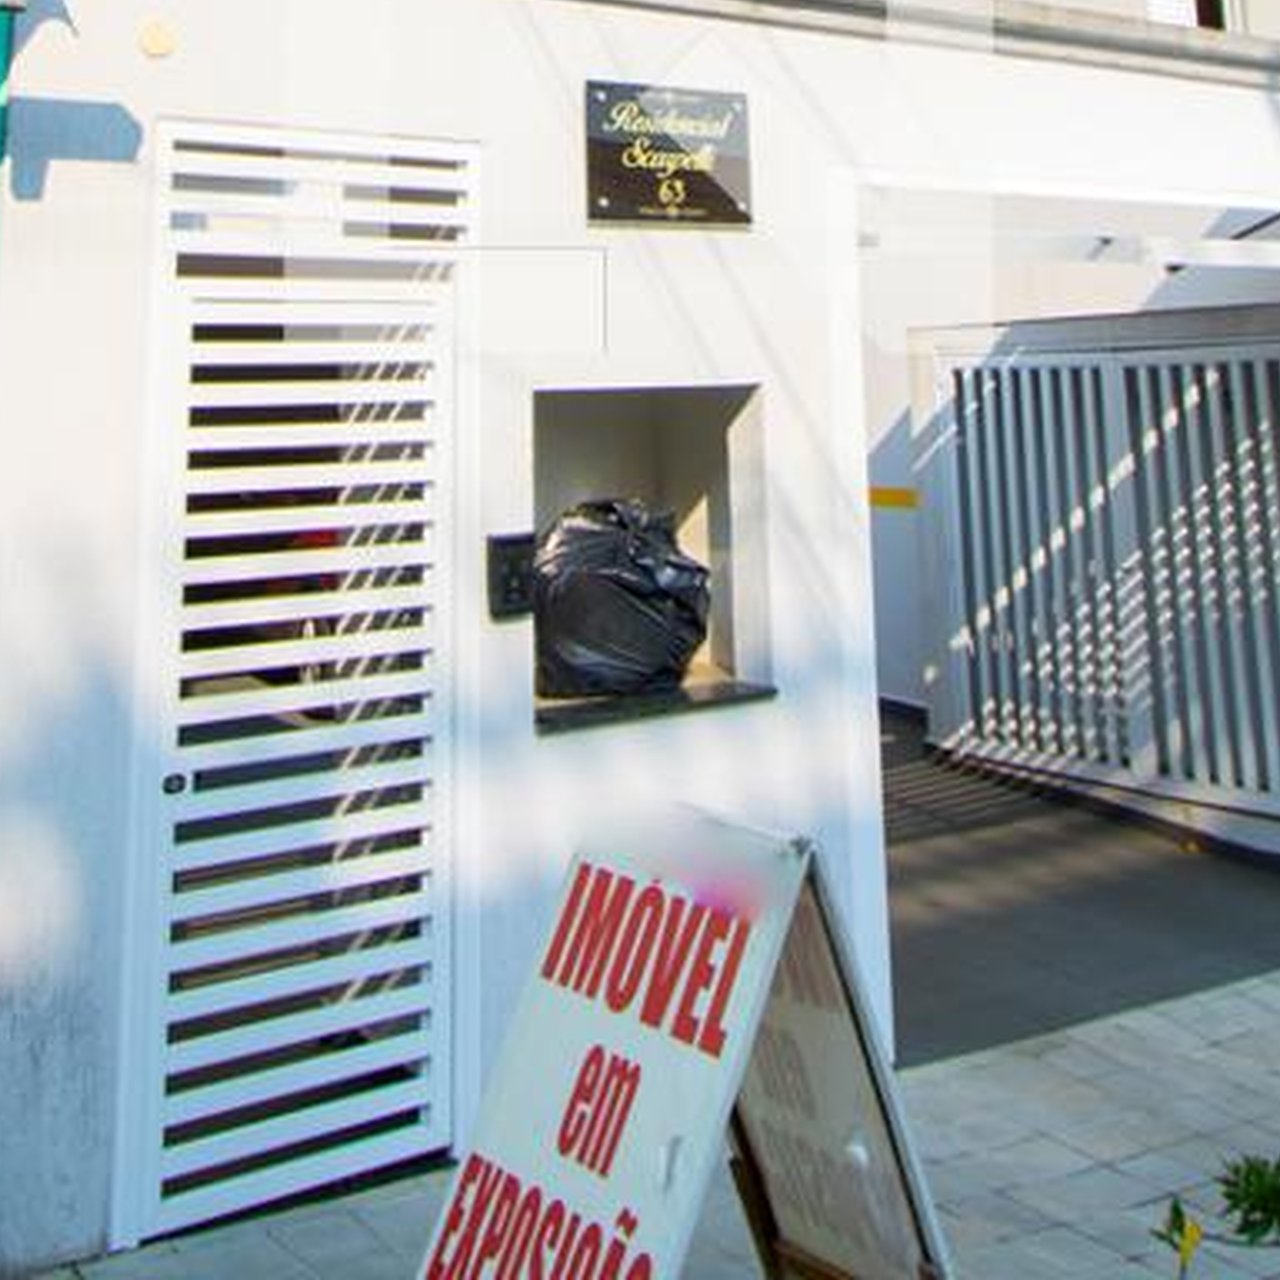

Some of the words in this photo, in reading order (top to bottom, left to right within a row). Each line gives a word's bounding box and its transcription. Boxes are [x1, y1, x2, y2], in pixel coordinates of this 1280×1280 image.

[657, 179, 686, 205] 63
[557, 1044, 641, 1177] em
[424, 1151, 652, 1280] EXPOSI
